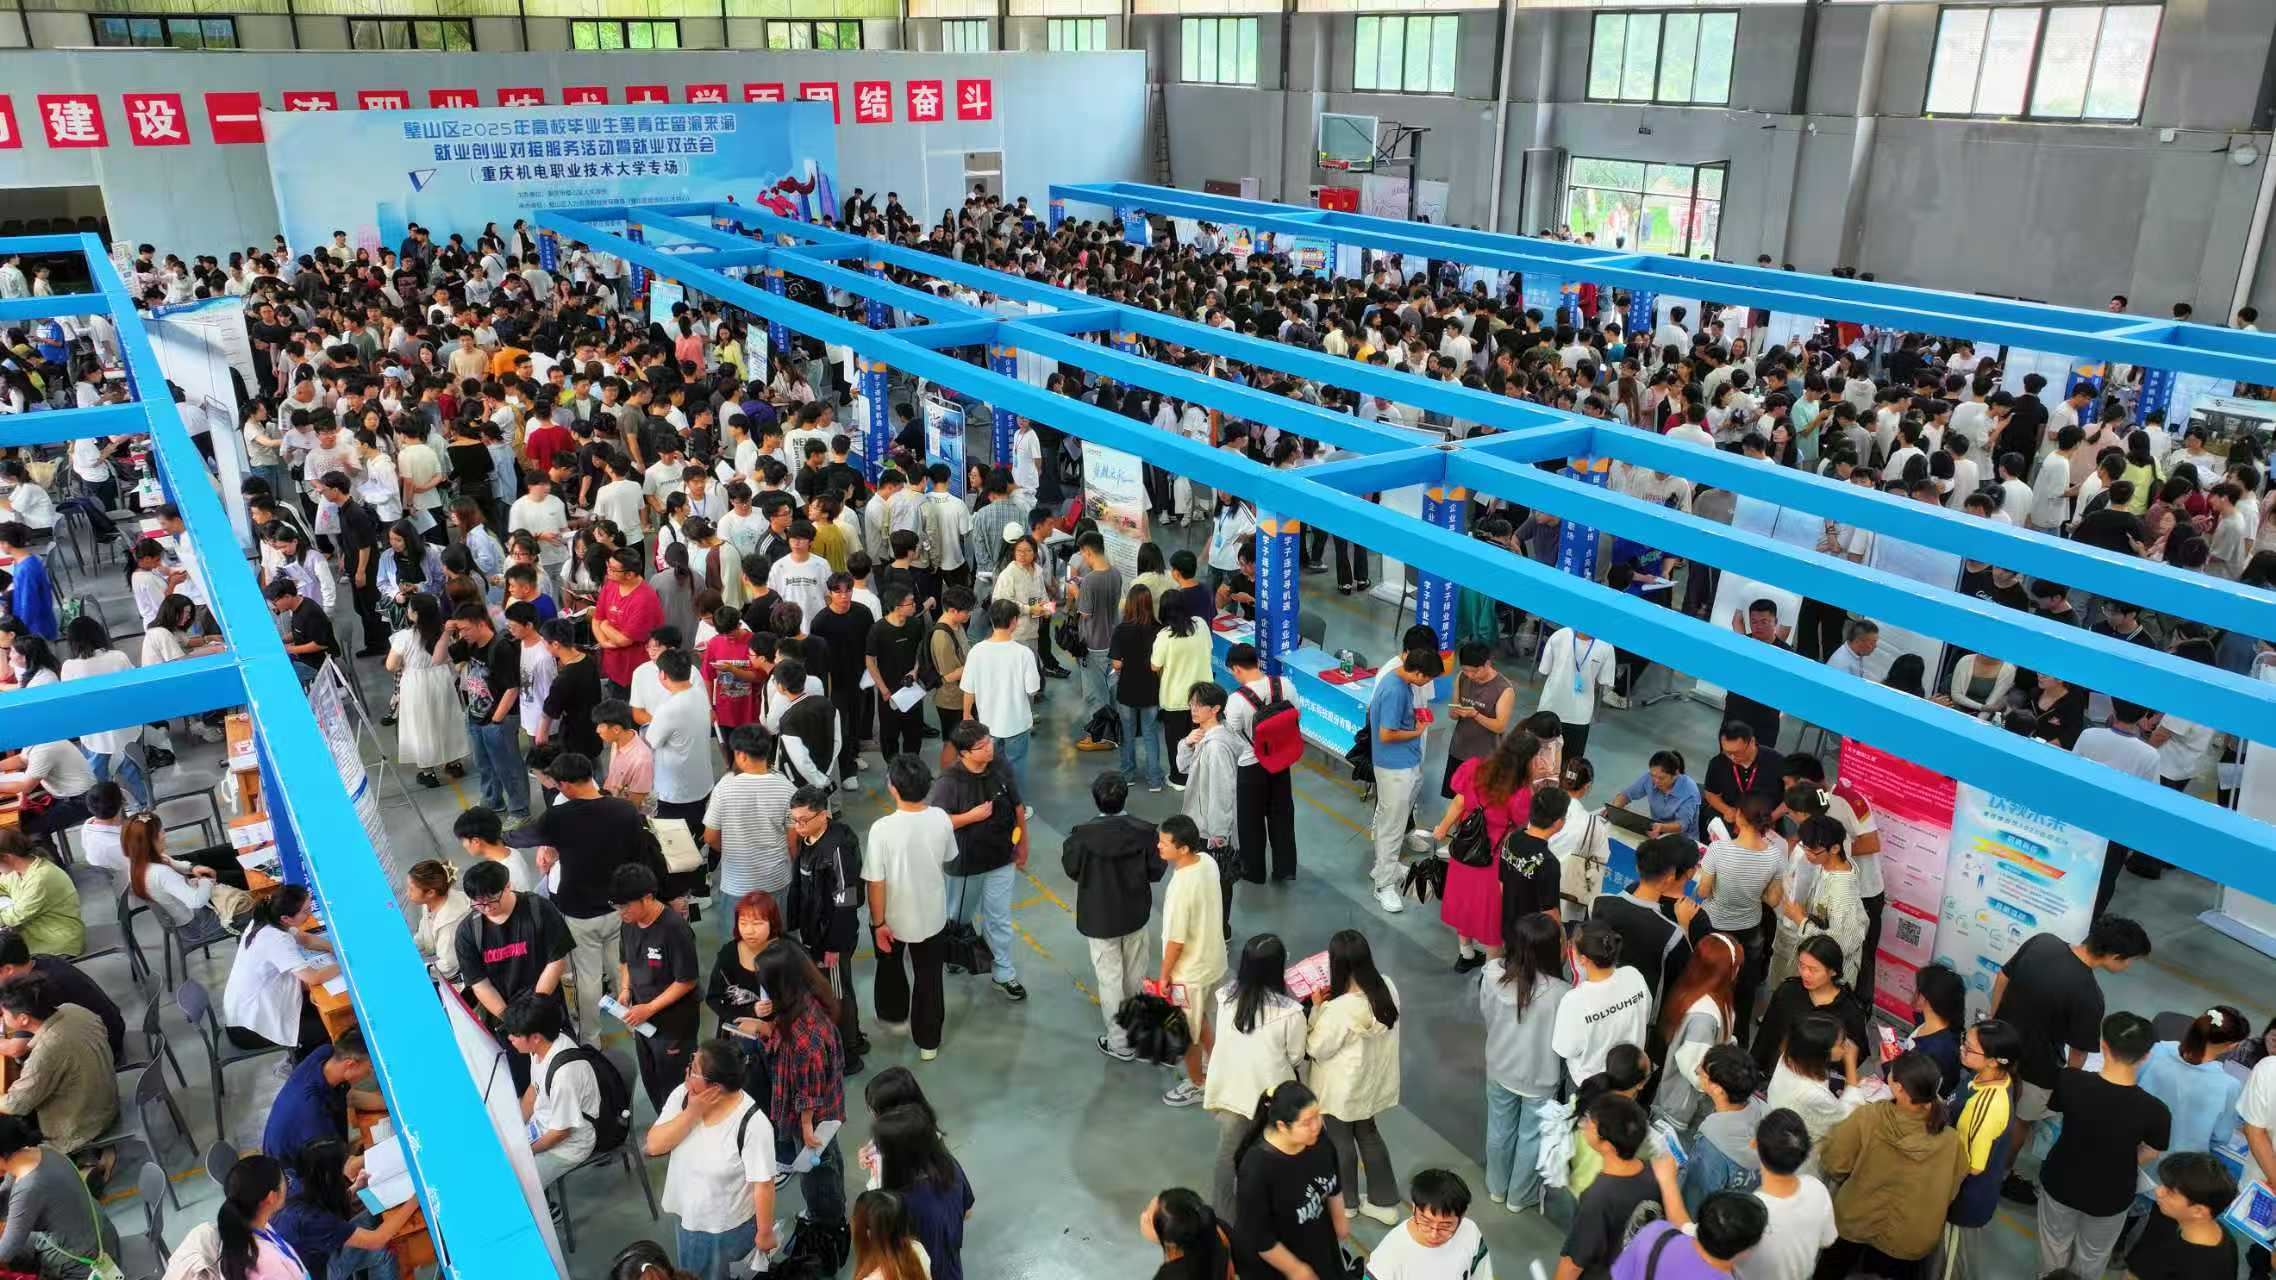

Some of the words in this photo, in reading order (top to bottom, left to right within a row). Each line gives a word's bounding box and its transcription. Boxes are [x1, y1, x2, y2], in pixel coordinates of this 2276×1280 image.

[403, 114, 735, 139] 璧山区2025年高校毕业生等青年留渝来渝
[434, 136, 714, 161] 就业创业对接服务活动暨就业双选会
